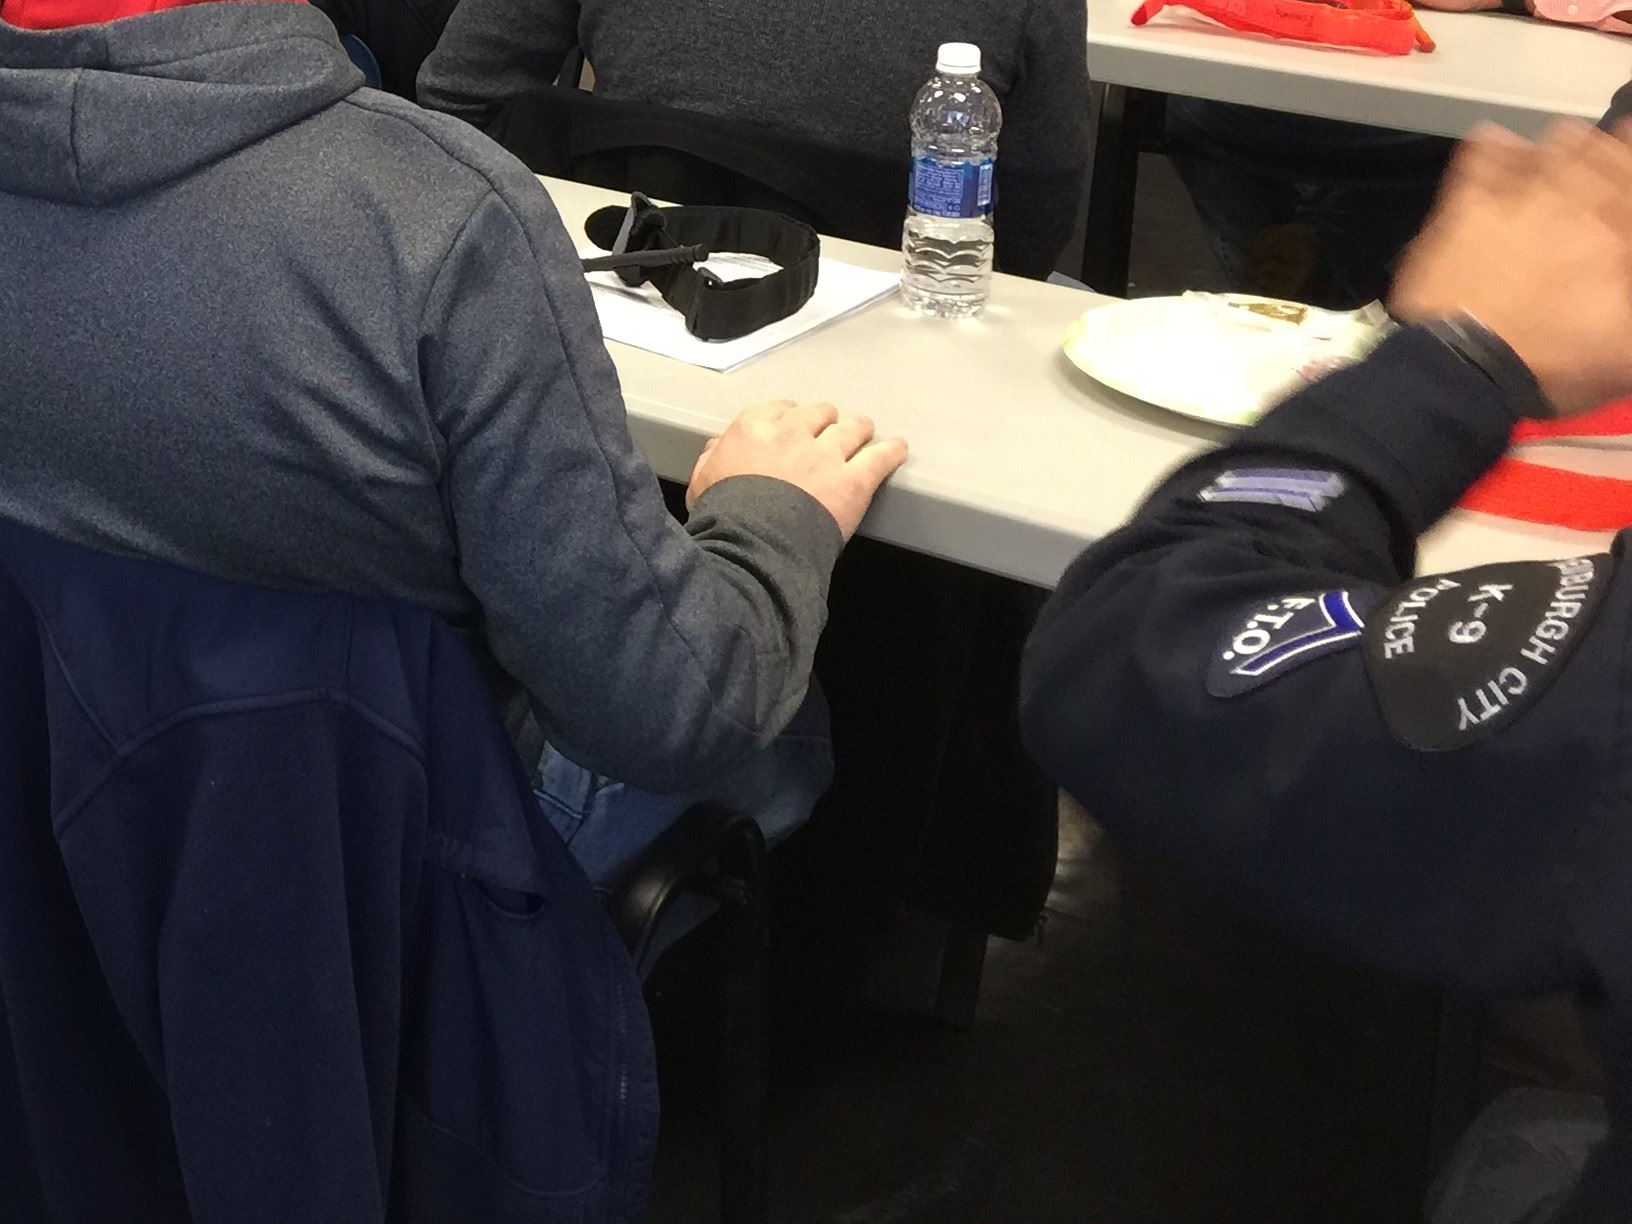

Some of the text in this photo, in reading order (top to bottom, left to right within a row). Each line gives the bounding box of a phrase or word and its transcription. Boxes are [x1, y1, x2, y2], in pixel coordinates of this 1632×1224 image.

[1383, 578, 1461, 660] POLICE
[1448, 583, 1514, 644] K-9
[1456, 666, 1528, 732] CITY
